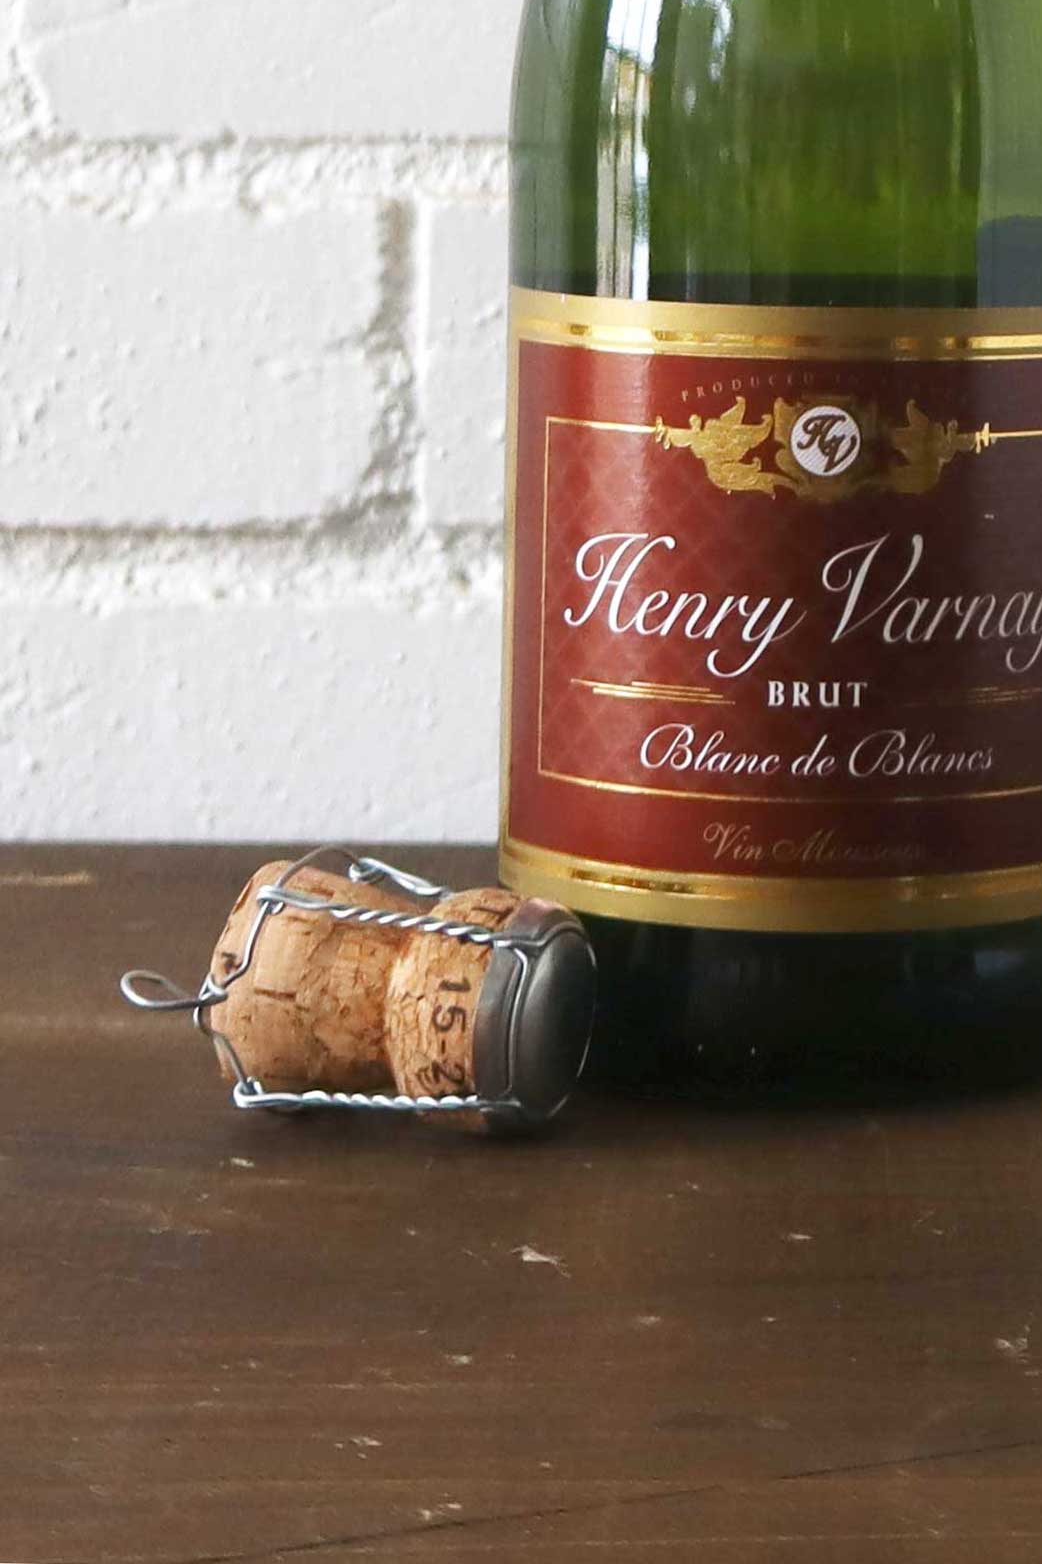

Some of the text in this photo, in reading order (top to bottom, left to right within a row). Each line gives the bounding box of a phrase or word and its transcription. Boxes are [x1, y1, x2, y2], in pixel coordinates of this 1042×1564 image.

[682, 373, 815, 402] PRODUCED
[563, 532, 807, 678] Henry
[766, 680, 869, 709] BRUT
[639, 722, 994, 777] Blanc de Blancs
[703, 821, 765, 861] Vin
